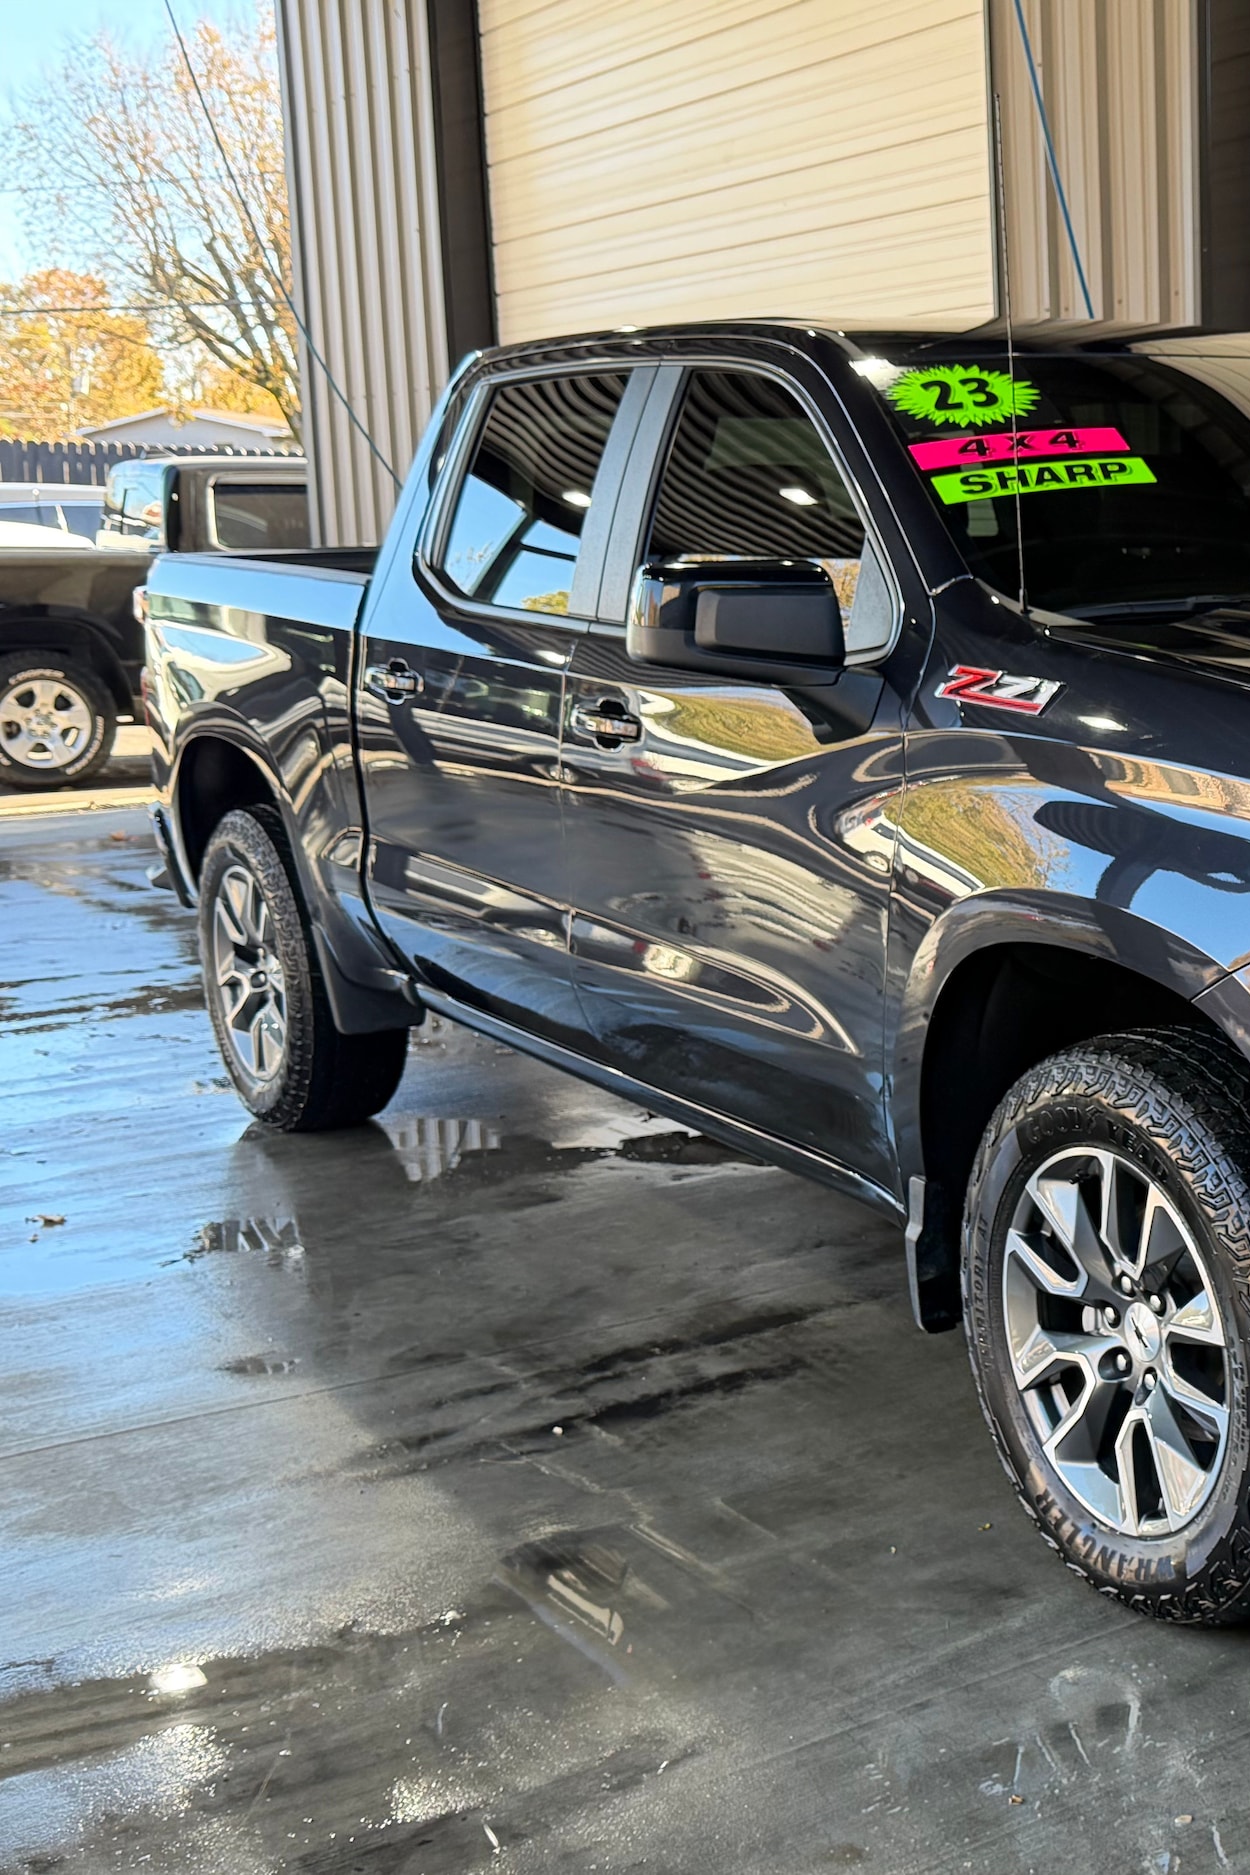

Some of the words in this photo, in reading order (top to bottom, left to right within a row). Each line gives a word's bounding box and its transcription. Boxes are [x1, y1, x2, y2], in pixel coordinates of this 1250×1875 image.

[919, 376, 999, 411] 23
[959, 461, 1130, 496] SHARP
[934, 664, 1062, 716] Z71
[1035, 1488, 1176, 1581] WRANGLER
